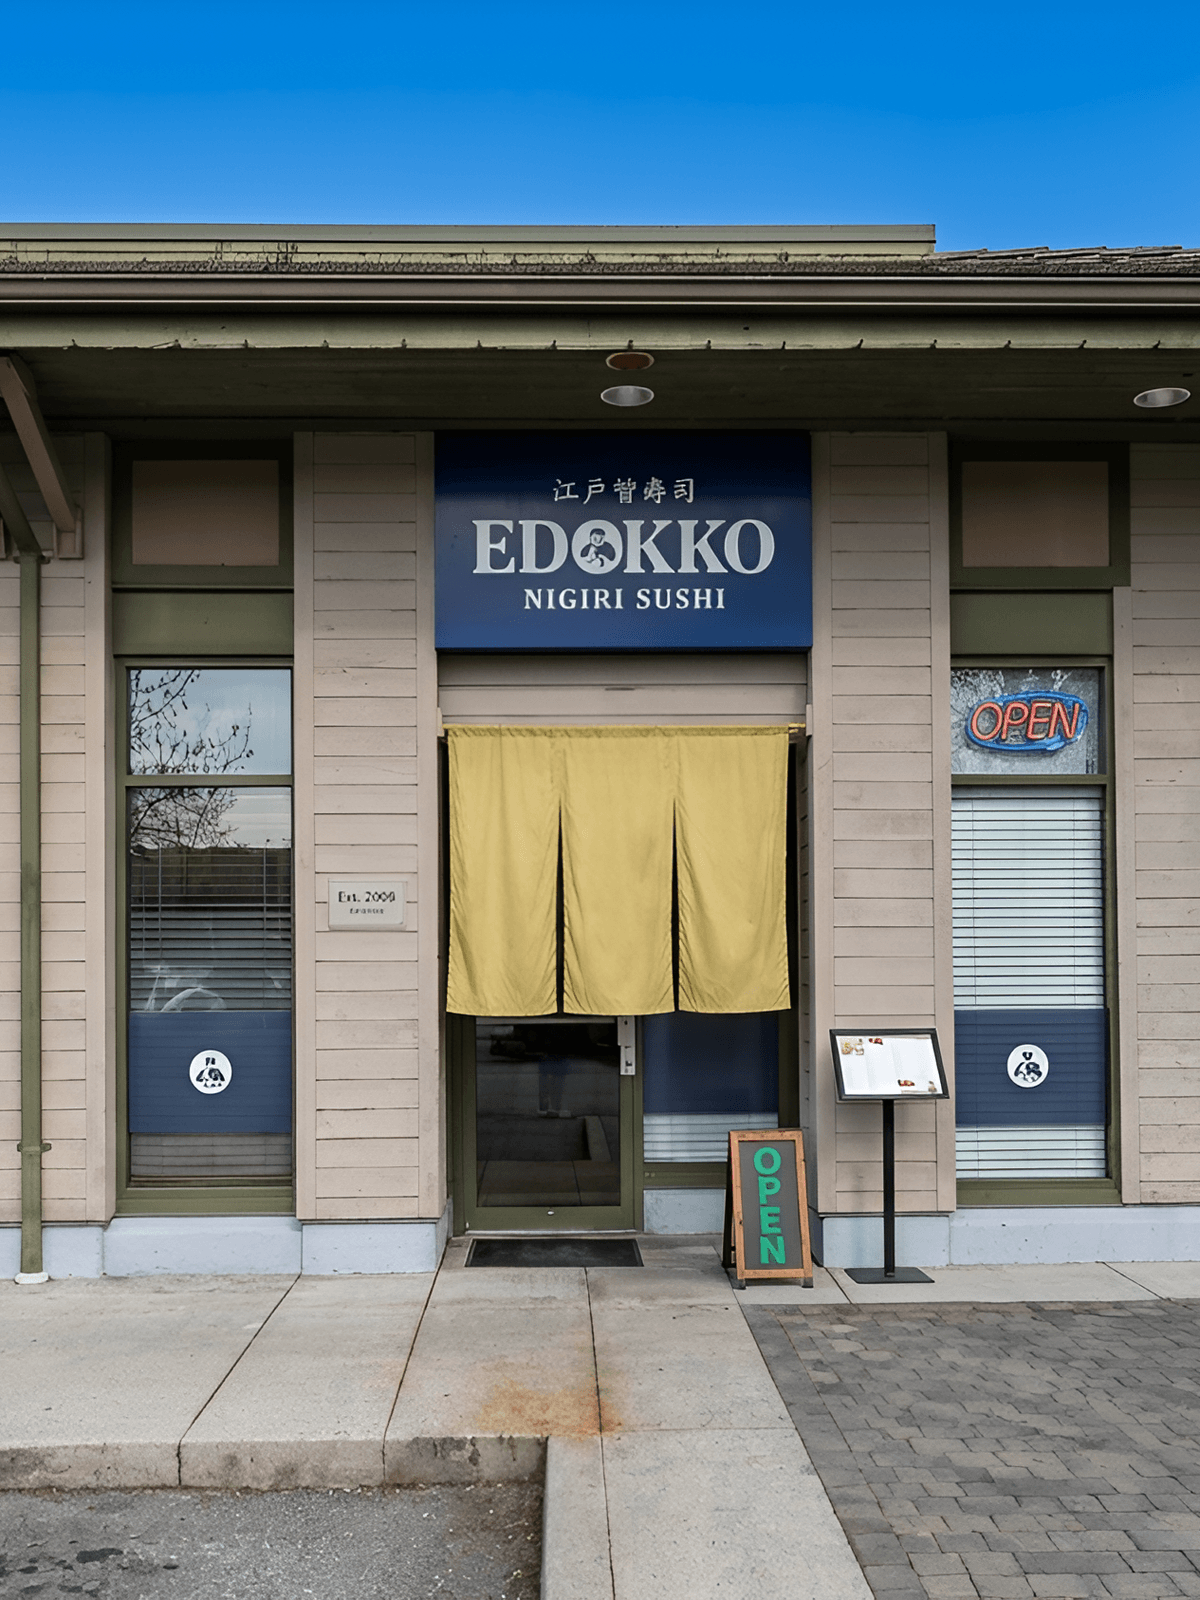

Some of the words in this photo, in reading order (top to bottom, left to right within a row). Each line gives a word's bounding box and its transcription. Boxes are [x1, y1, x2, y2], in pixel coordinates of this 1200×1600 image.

[472, 520, 775, 575] EDOKKO
[523, 588, 624, 610] NIGIRI
[635, 588, 726, 610] SUSHI
[971, 701, 1080, 741] OPEN
[753, 1147, 786, 1264] OPEN
